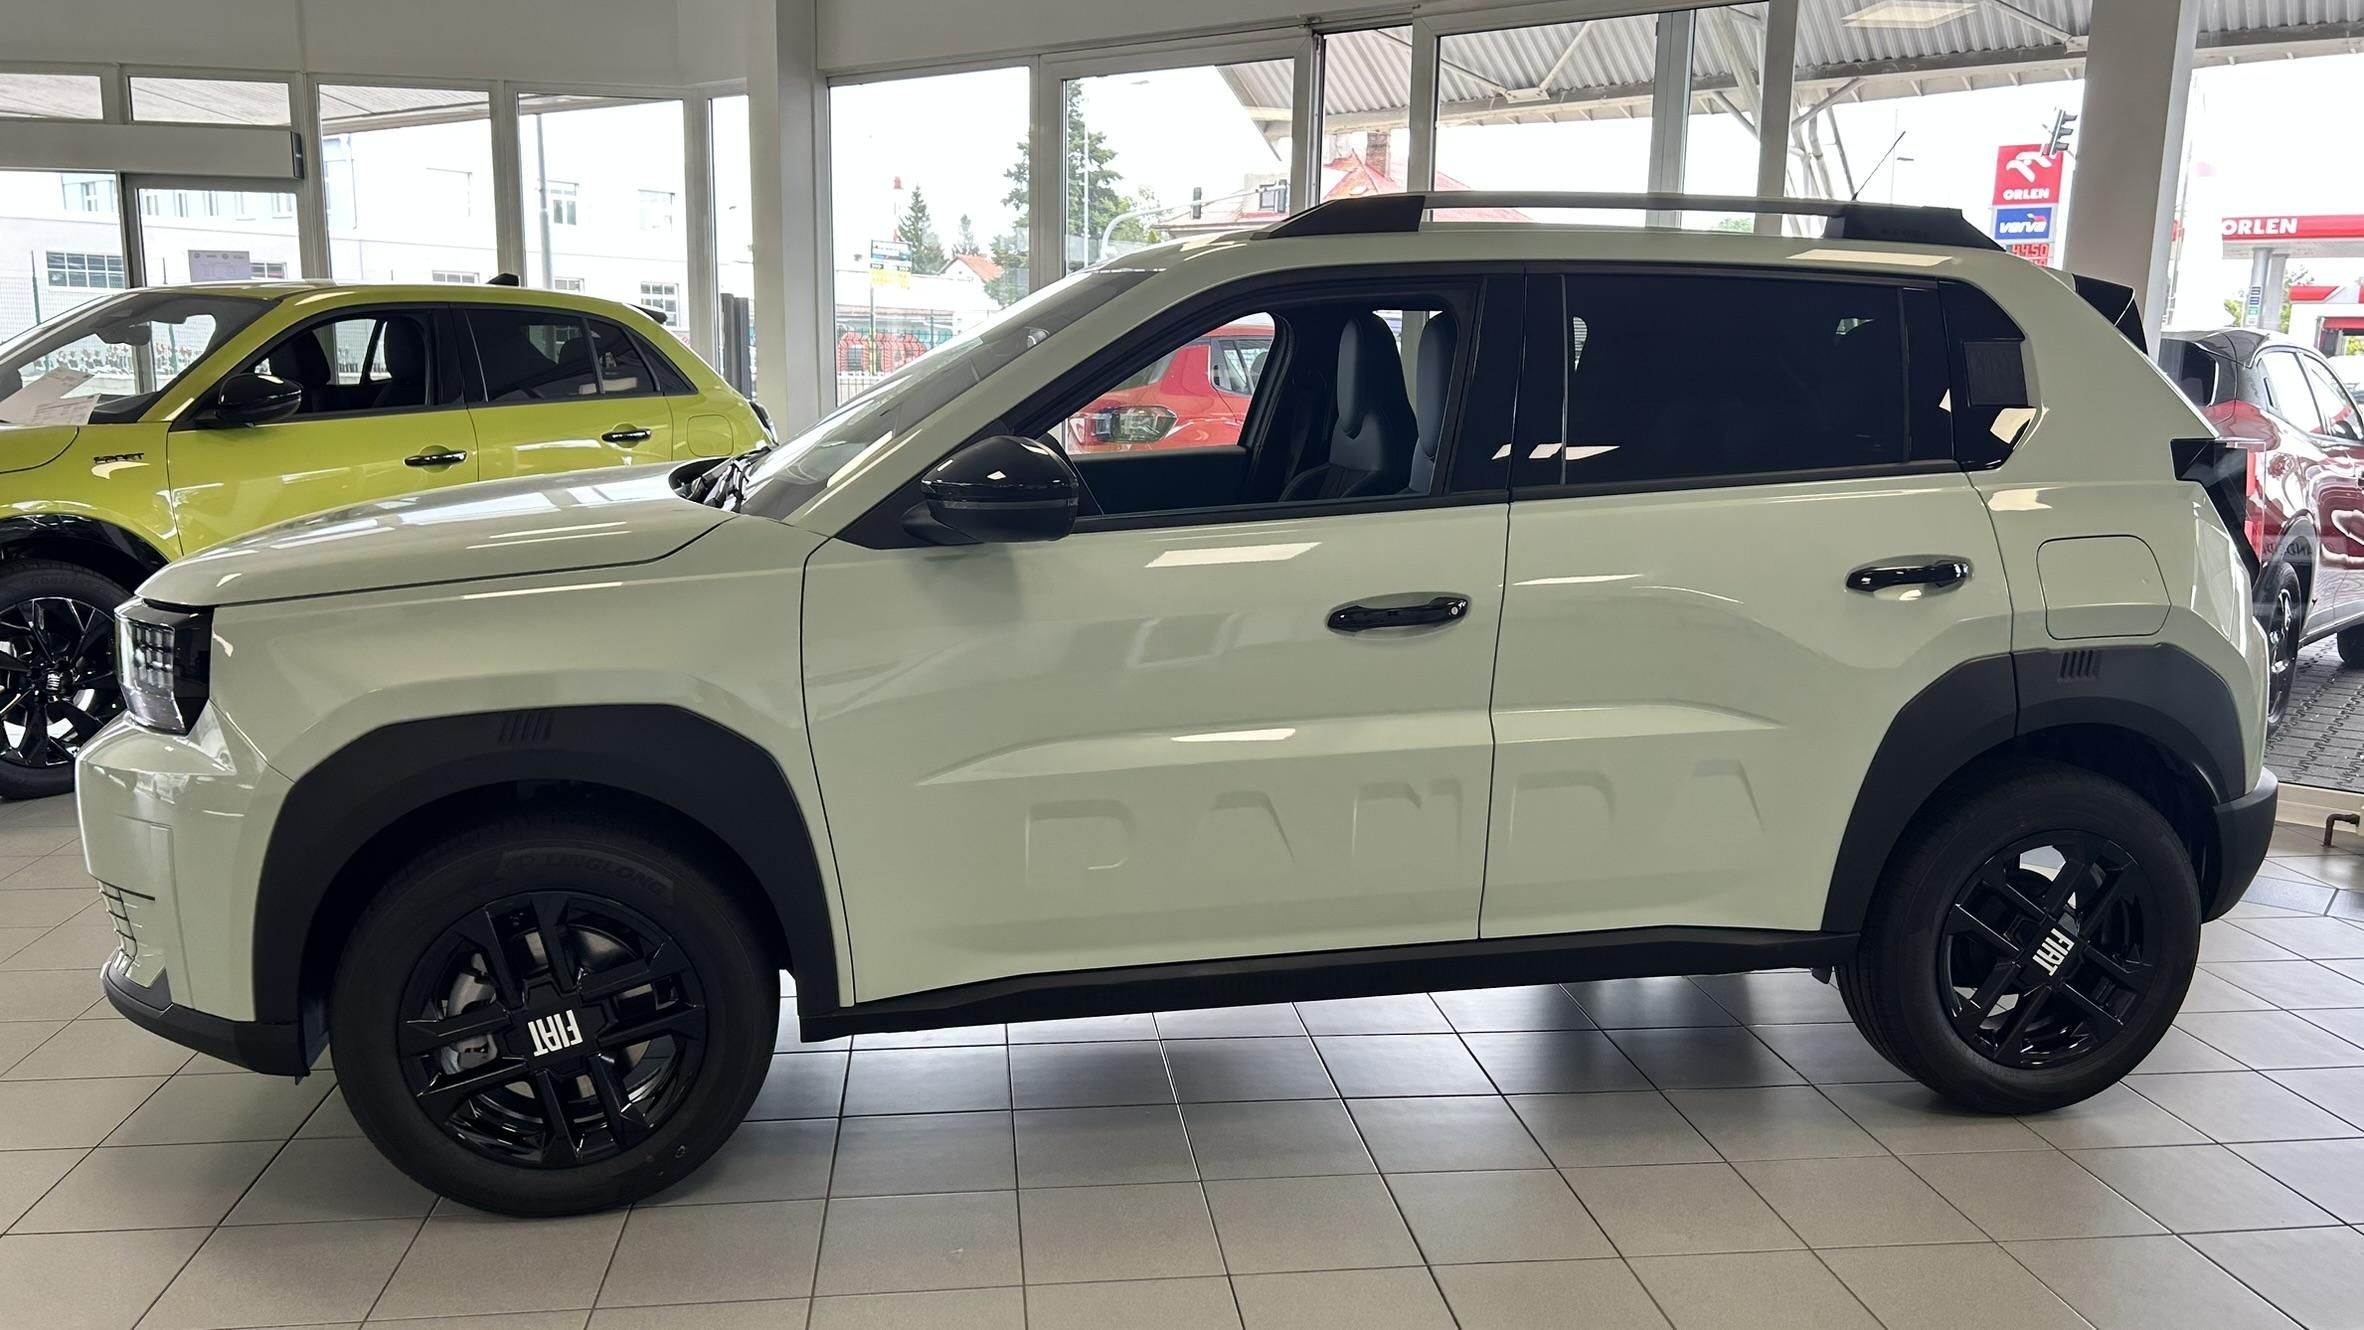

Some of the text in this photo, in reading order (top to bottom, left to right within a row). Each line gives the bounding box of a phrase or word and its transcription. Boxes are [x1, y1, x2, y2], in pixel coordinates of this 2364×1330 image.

[2003, 188, 2049, 200] ORLEN
[2222, 217, 2298, 236] ORLEN
[2032, 928, 2075, 976] FIAT
[527, 1009, 583, 1057] FIAT
